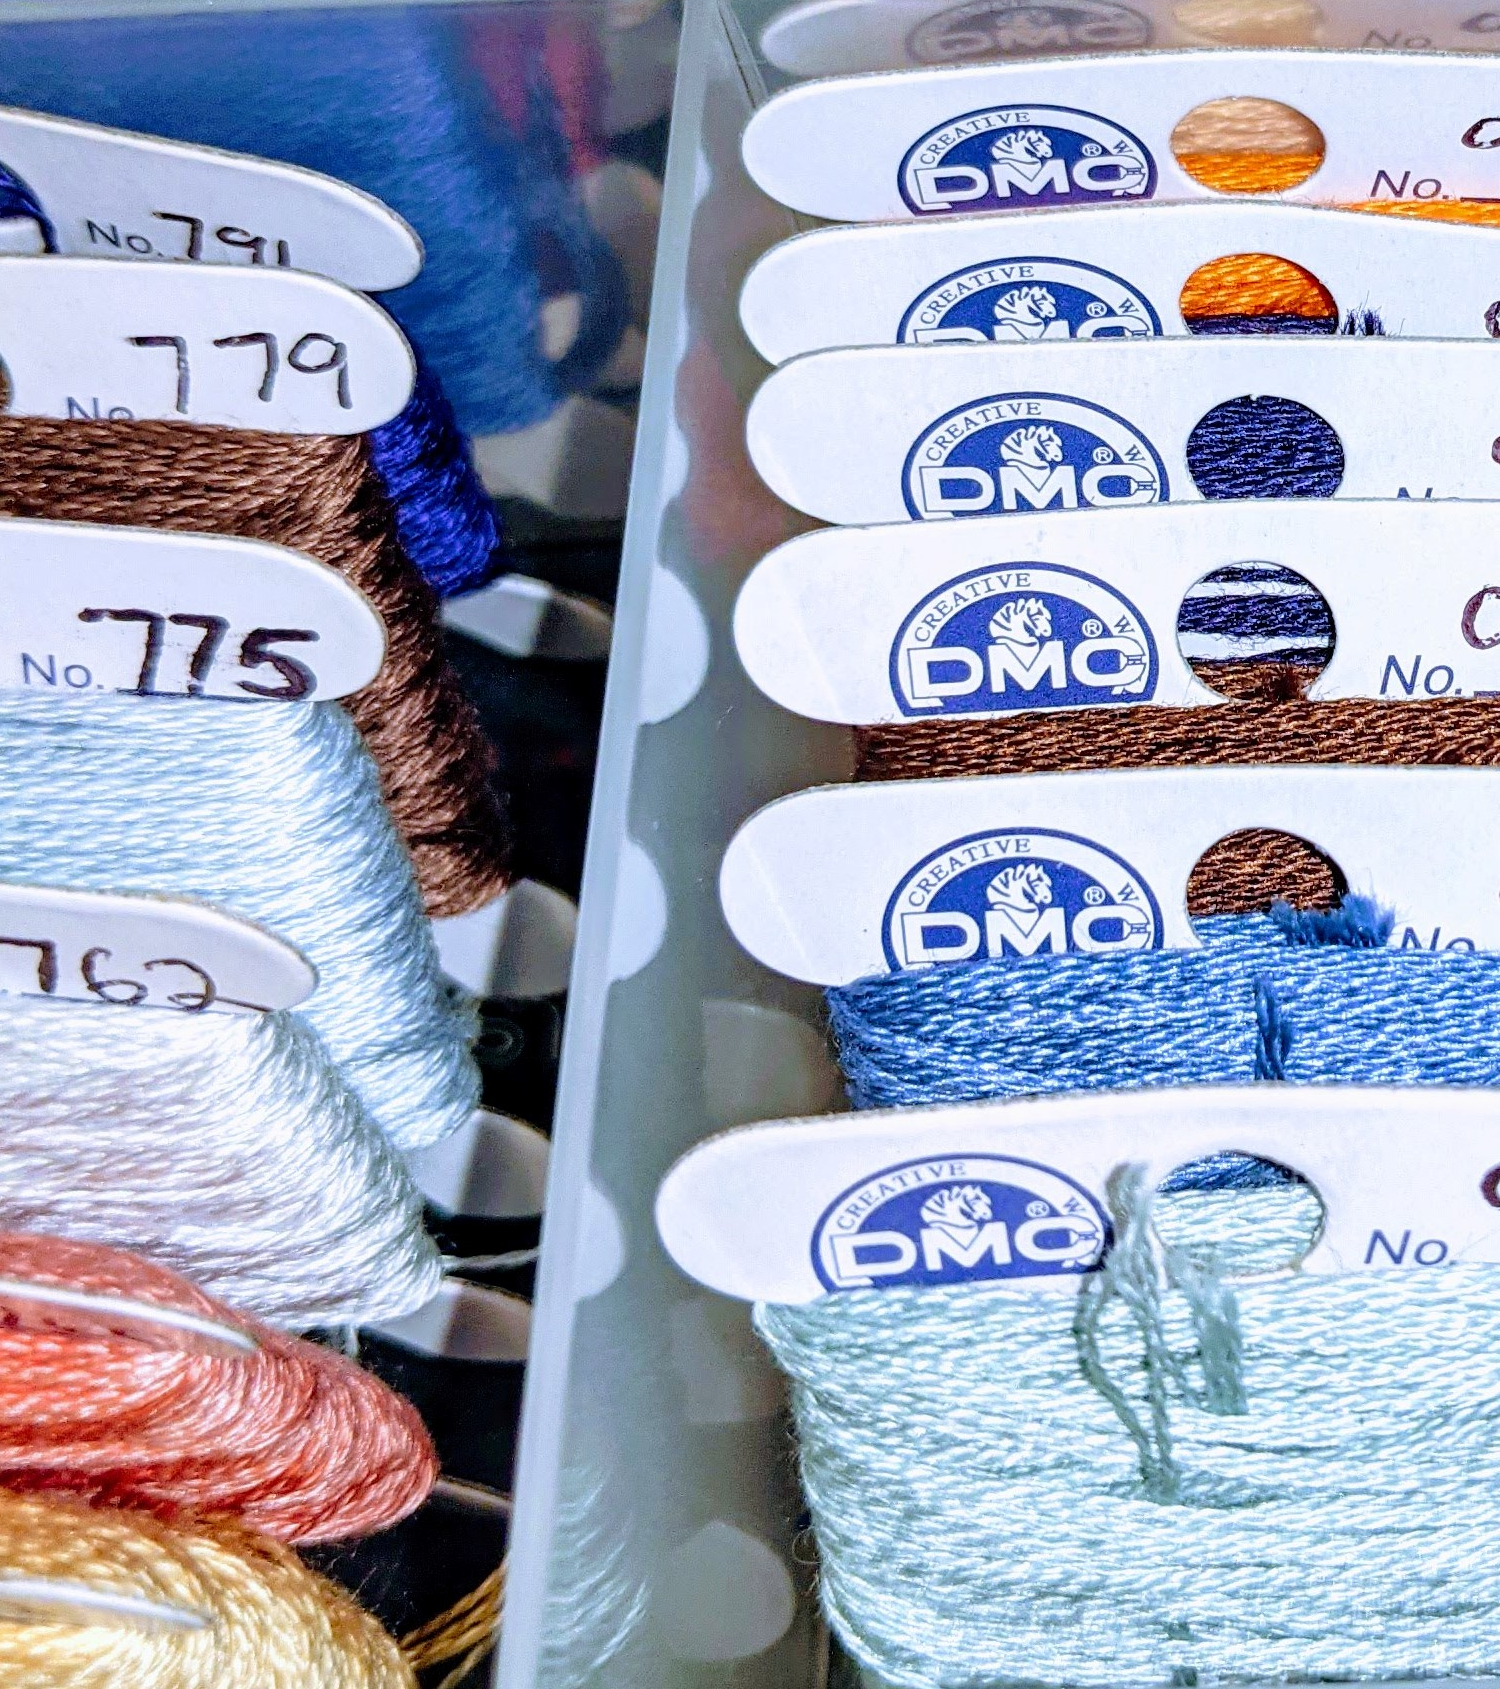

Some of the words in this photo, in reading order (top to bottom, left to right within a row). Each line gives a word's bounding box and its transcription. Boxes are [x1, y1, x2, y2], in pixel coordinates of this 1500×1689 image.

[919, 112, 1031, 166] CREATIVE
[914, 154, 1146, 206] DMC
[1370, 169, 1450, 200] No.
[86, 220, 165, 257] No.
[152, 211, 291, 267] 791
[920, 265, 1035, 325] CREATIVE
[126, 332, 353, 415] 779
[926, 402, 1037, 463] CREATIVE
[919, 462, 1157, 513] DMC
[914, 573, 1031, 643] CREATIVE
[22, 653, 104, 691] No.
[79, 607, 321, 700] 775
[907, 635, 1147, 699] DMC
[1380, 655, 1462, 696] No.
[908, 838, 1031, 908] CREATIVE
[901, 903, 1150, 965] DMC
[0, 937, 273, 1012] 762
[836, 1162, 967, 1232] CREATIVE
[830, 1214, 1100, 1280] DMC
